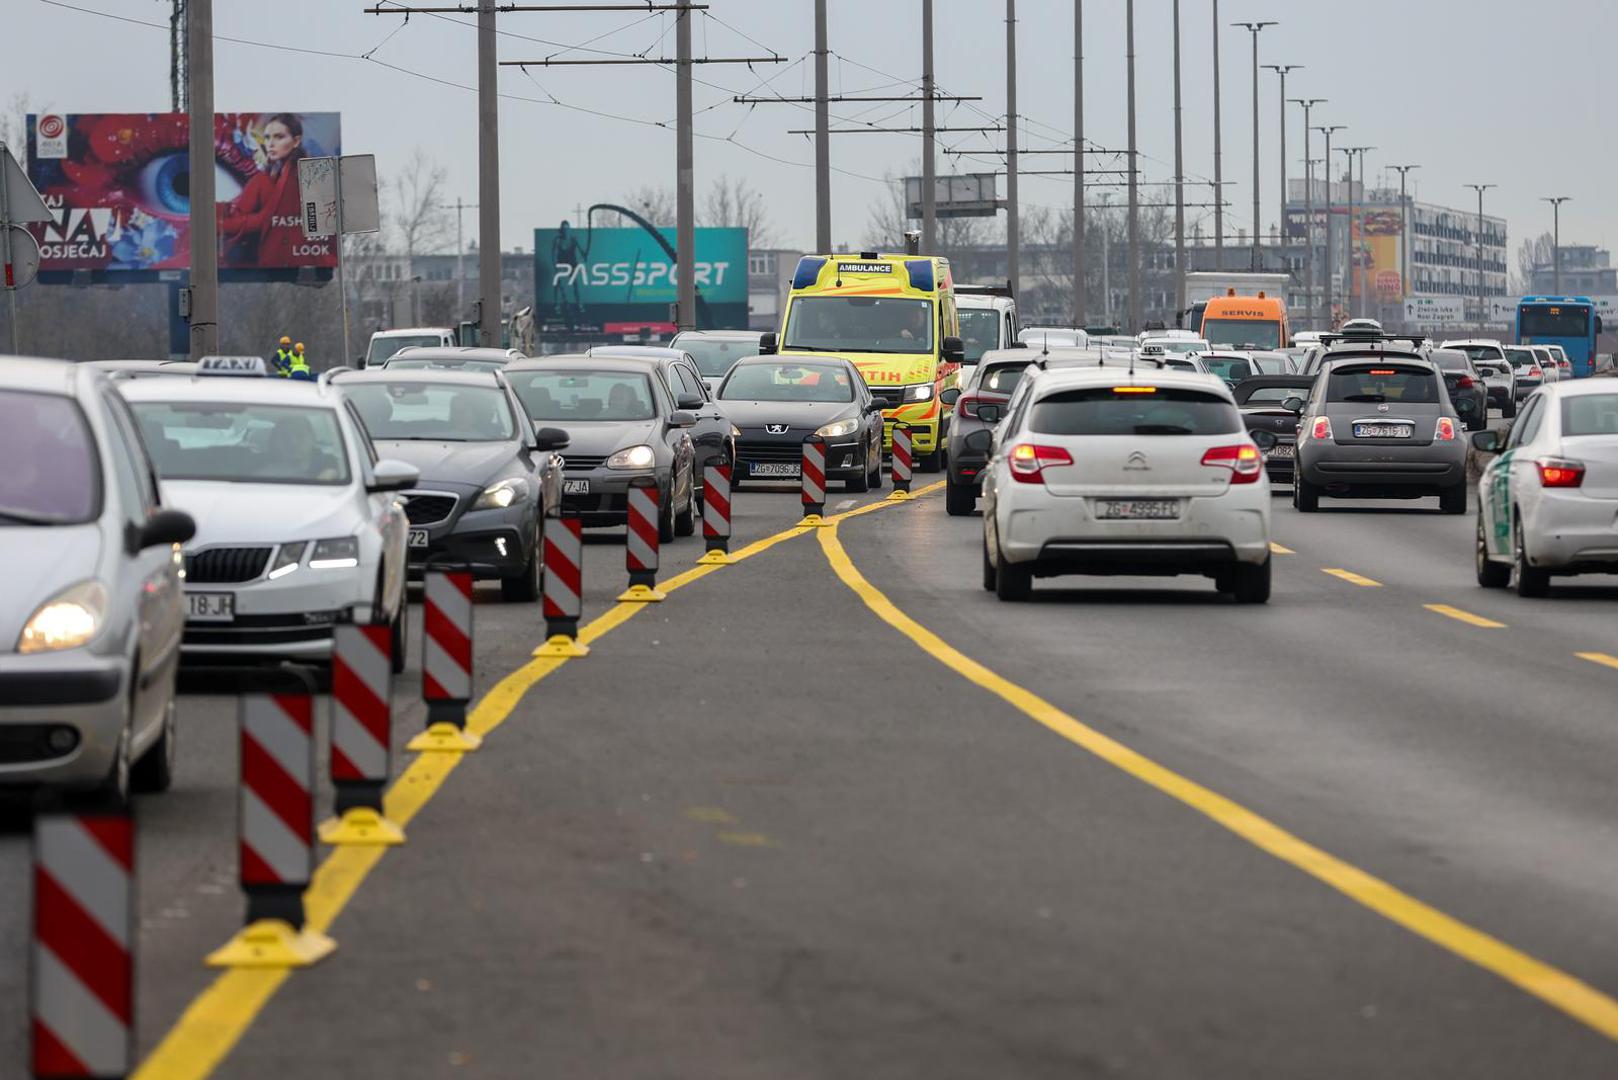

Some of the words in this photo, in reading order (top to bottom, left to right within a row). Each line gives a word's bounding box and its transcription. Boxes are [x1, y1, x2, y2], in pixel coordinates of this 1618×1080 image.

[292, 246, 330, 256] LOOK
[839, 264, 891, 272] AMBULANCE
[203, 358, 257, 369] TAXI
[756, 464, 766, 474] ZG
[409, 531, 426, 545] 72
